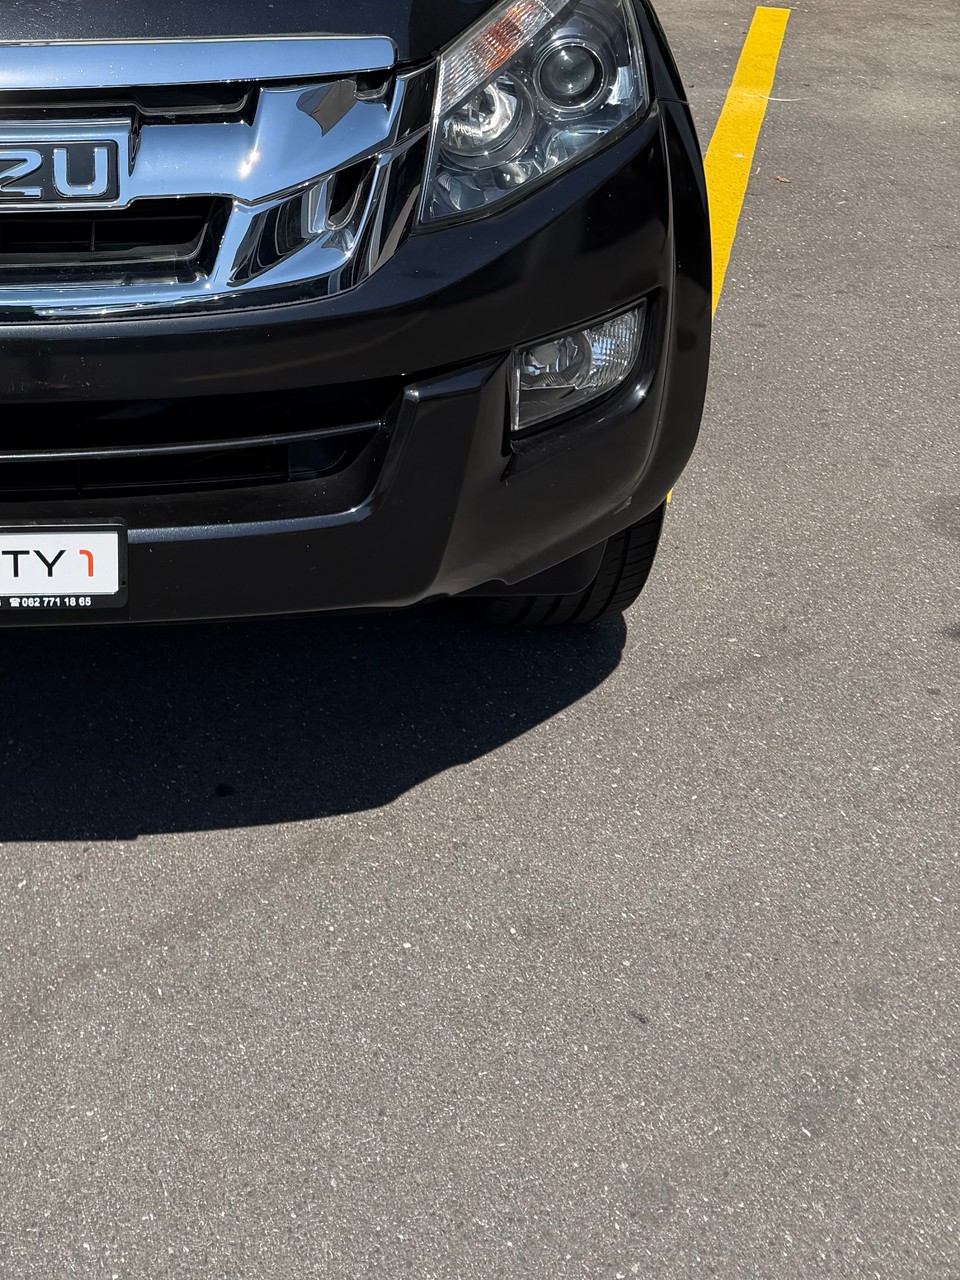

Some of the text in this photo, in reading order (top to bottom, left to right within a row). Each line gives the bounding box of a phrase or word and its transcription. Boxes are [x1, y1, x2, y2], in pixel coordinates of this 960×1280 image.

[42, 597, 61, 608] 771
[63, 596, 77, 607] 18
[78, 596, 92, 607] 65
